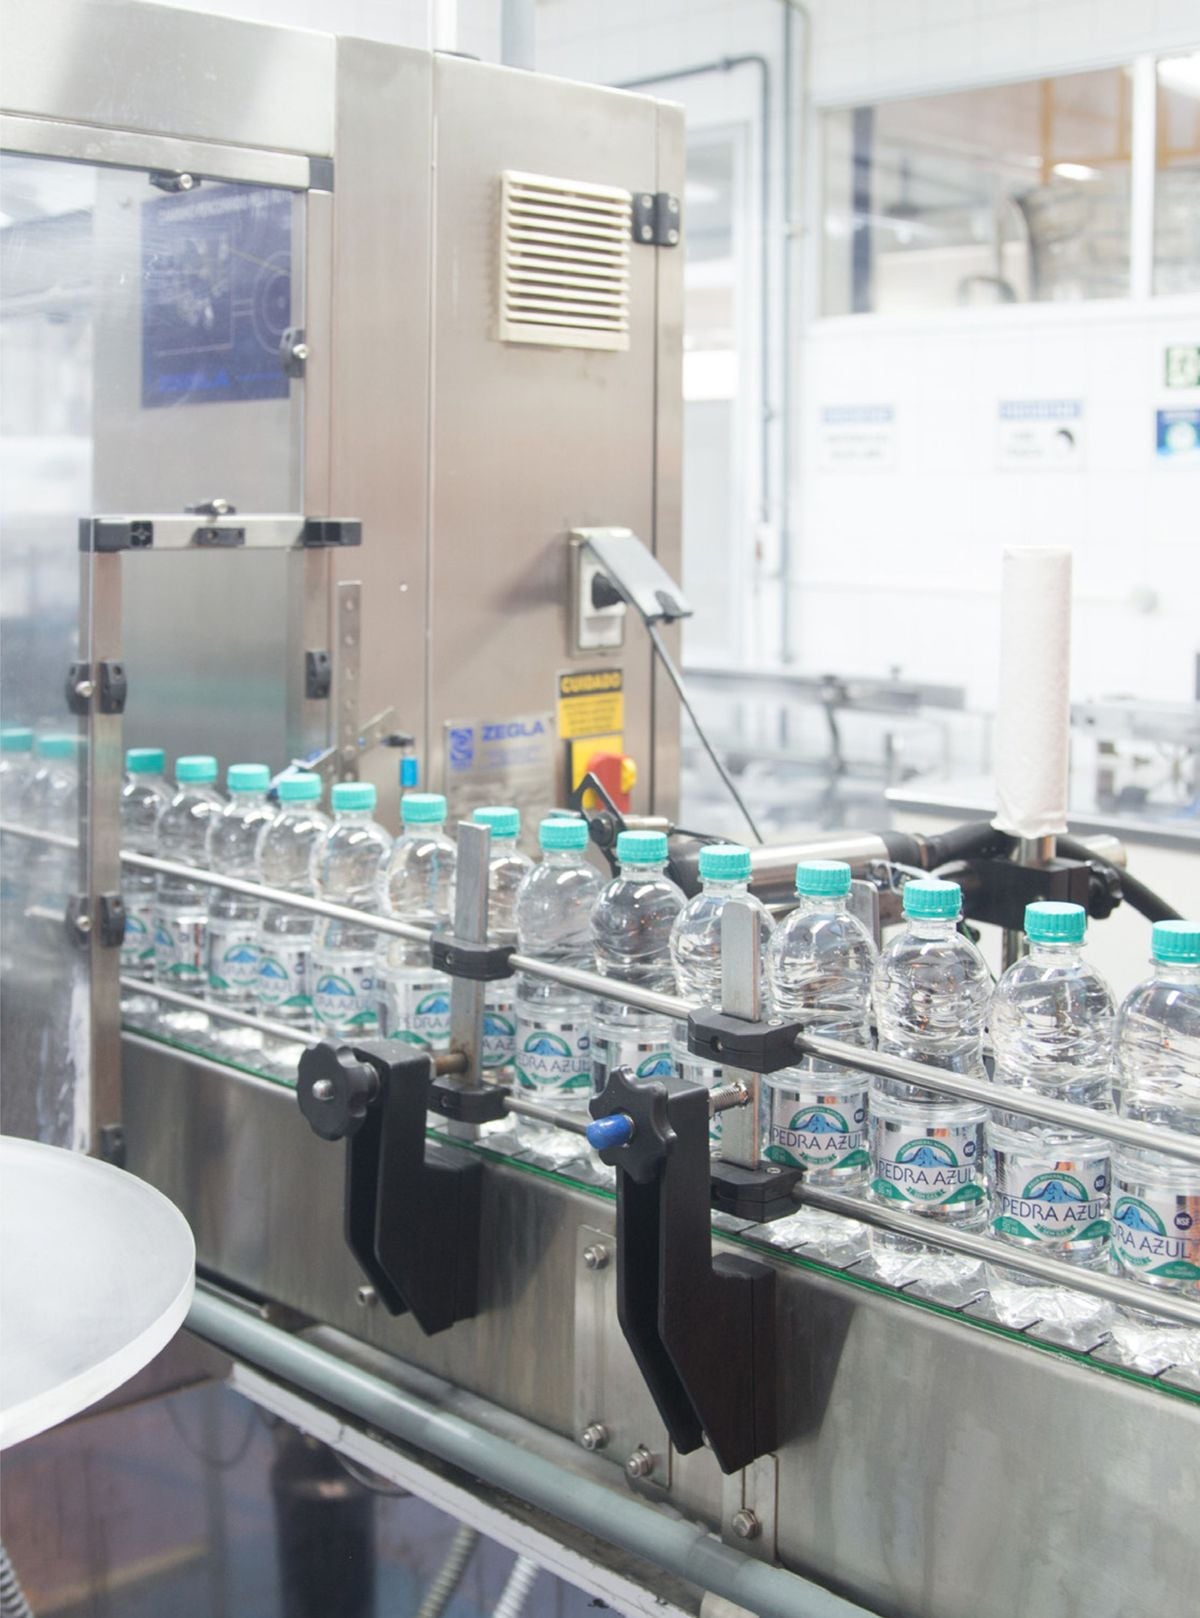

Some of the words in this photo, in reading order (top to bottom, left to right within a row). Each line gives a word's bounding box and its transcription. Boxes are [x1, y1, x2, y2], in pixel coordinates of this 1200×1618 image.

[561, 672, 620, 693] CUIDADO
[482, 720, 545, 742] ZEGLA
[496, 1039, 515, 1051] AZ
[772, 1128, 822, 1151] PEDRA
[825, 1132, 865, 1151] AZUL
[878, 1159, 929, 1186] PEDRA
[932, 1167, 976, 1186] AZUL
[1002, 1196, 1059, 1222] PEDRA
[1063, 1201, 1105, 1222] AZUL
[1139, 1236, 1192, 1259] AZUL
